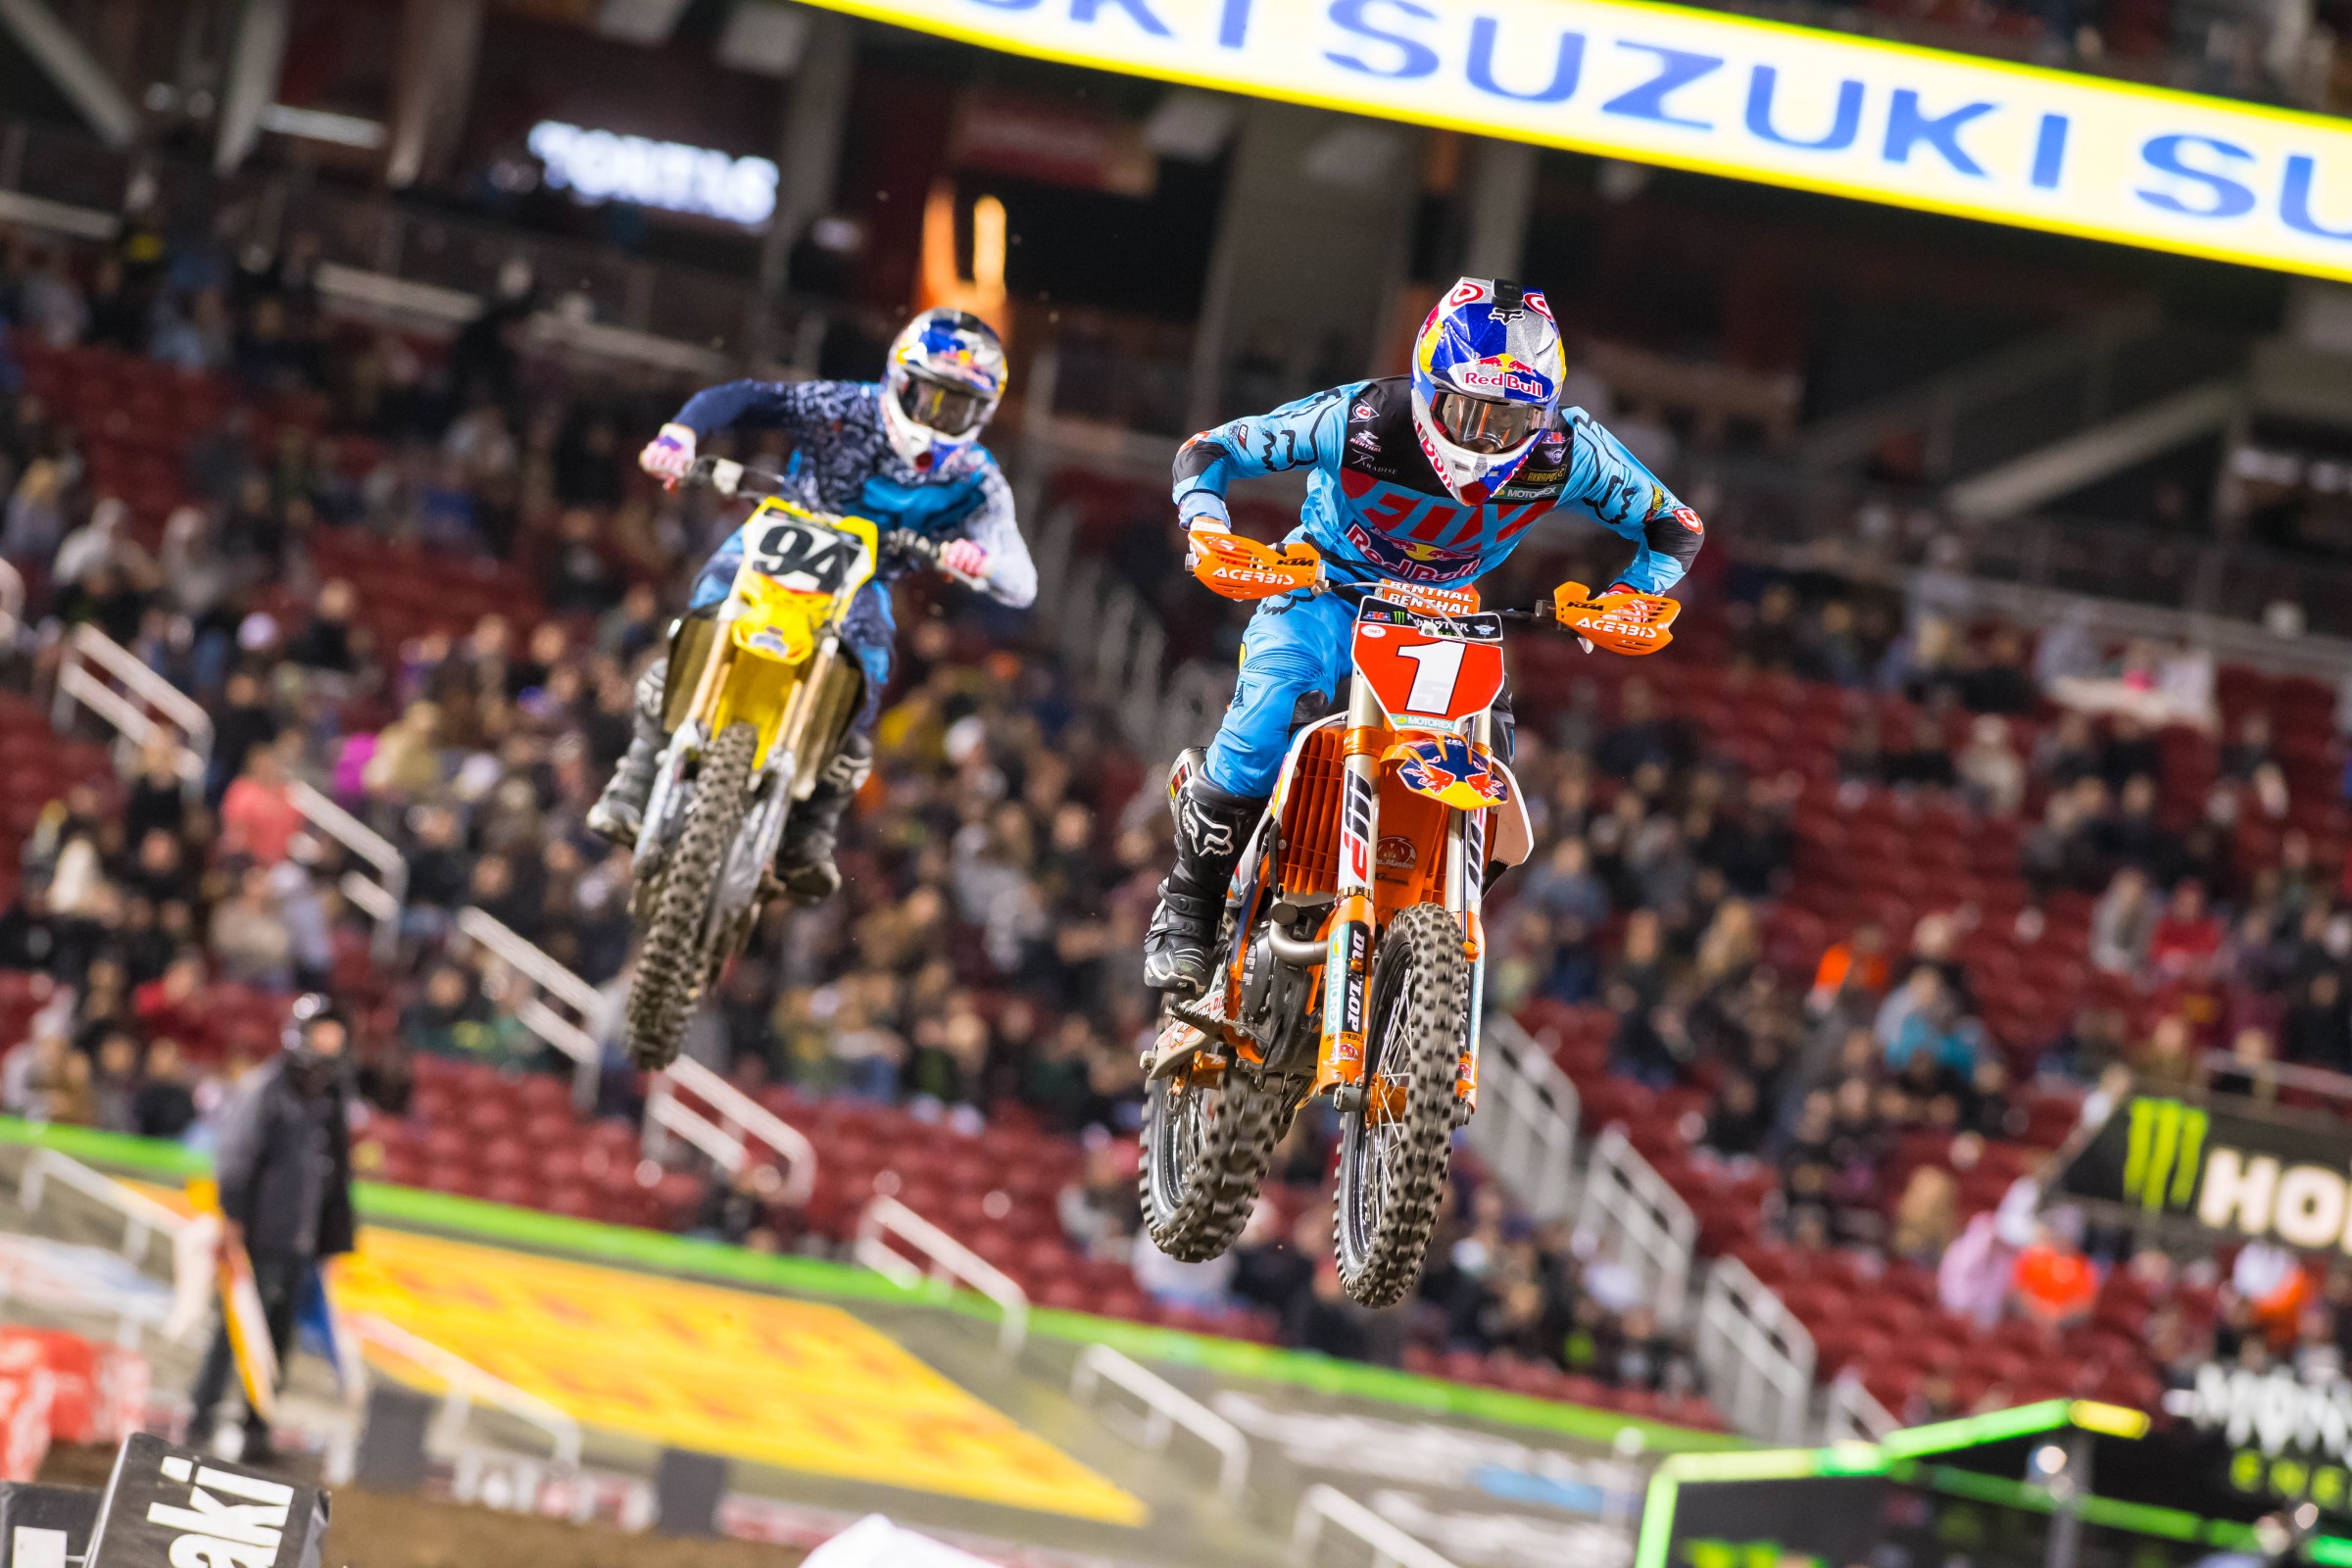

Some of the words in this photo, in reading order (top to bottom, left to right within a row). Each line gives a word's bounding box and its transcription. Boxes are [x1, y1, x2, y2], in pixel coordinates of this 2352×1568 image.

[1321, 0, 2070, 190] SUZUKI
[1464, 371, 1504, 386] Red
[1506, 374, 1543, 397] Bull
[753, 525, 859, 595] 94
[1276, 557, 1314, 567] KTM
[1346, 522, 1411, 580] Red
[1410, 558, 1483, 583] Bull
[1566, 601, 1604, 612] KTM
[1395, 639, 1467, 717] 1
[1407, 716, 1453, 730] MOTOREX
[2197, 1144, 2352, 1258] HO
